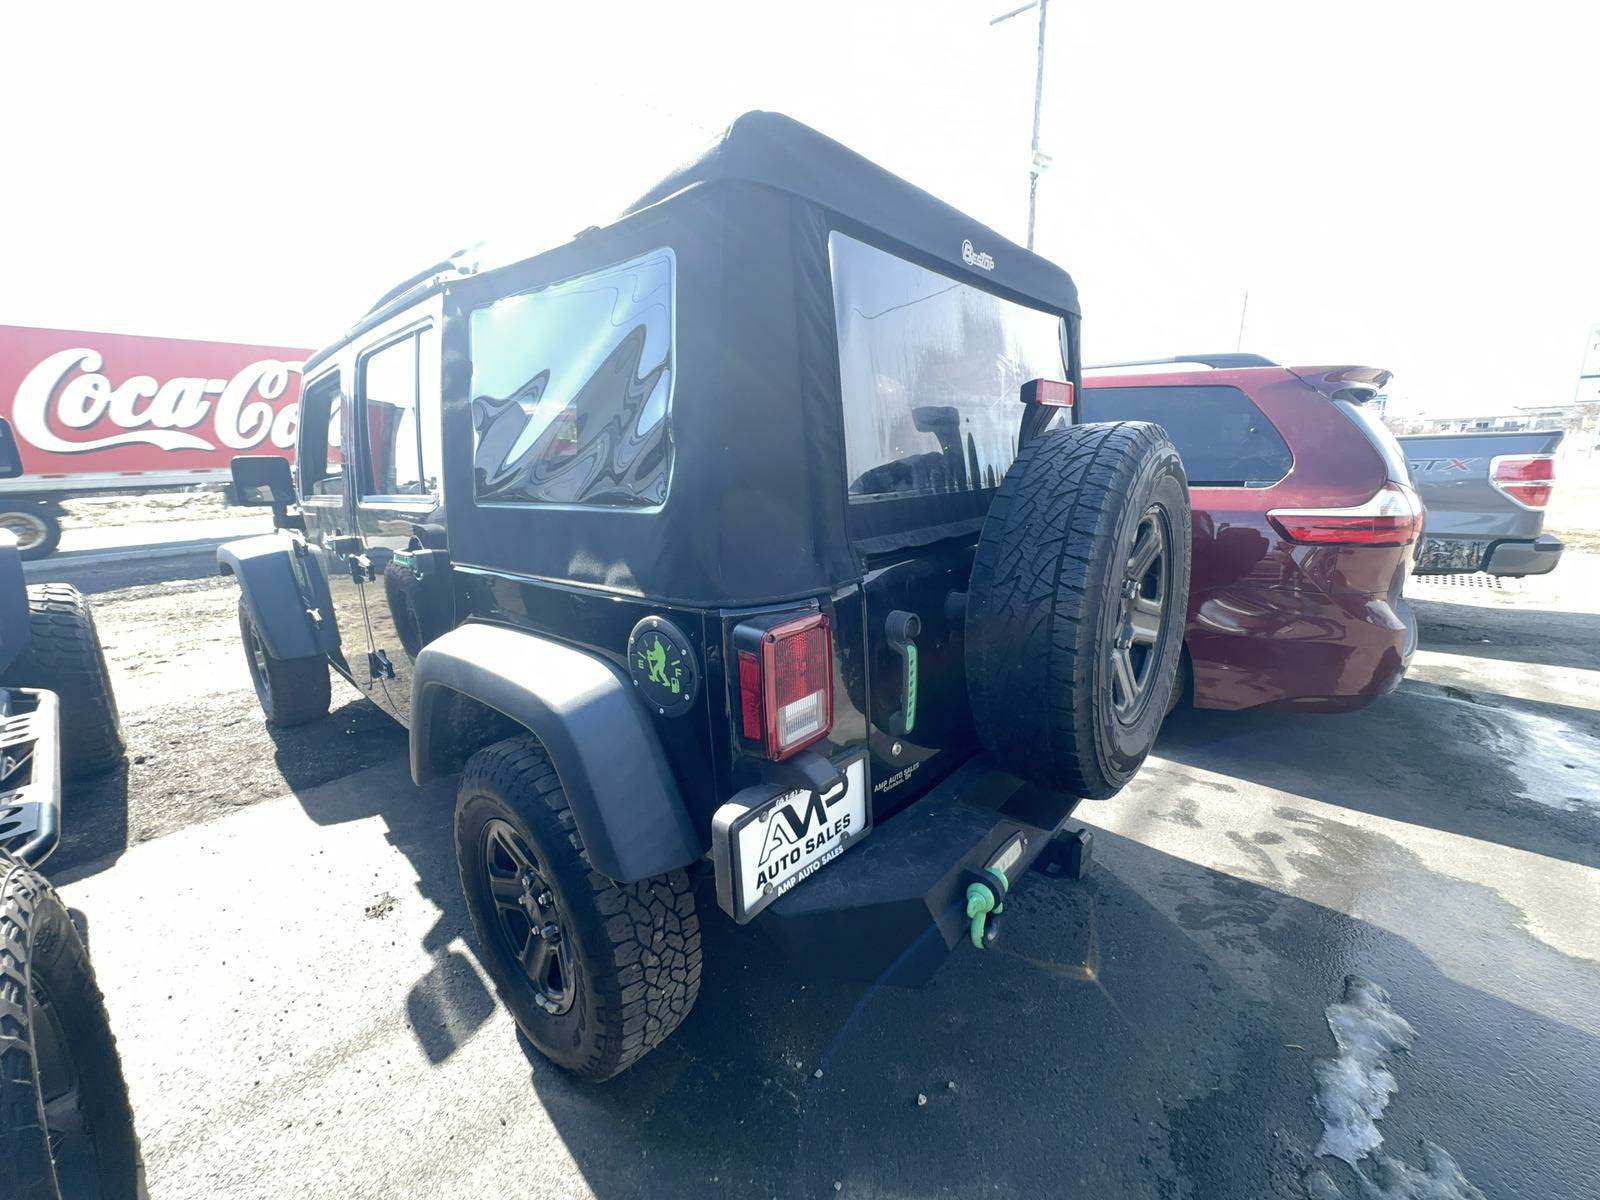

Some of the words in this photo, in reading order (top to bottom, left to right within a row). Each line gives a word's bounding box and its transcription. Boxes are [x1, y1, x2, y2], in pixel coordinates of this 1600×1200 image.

[757, 846, 801, 889] AUTO
[805, 813, 851, 854] SALES
[758, 772, 849, 868] AMP
[777, 877, 797, 896] AMP
[797, 859, 820, 882] AUTO
[821, 844, 844, 866] SALES
